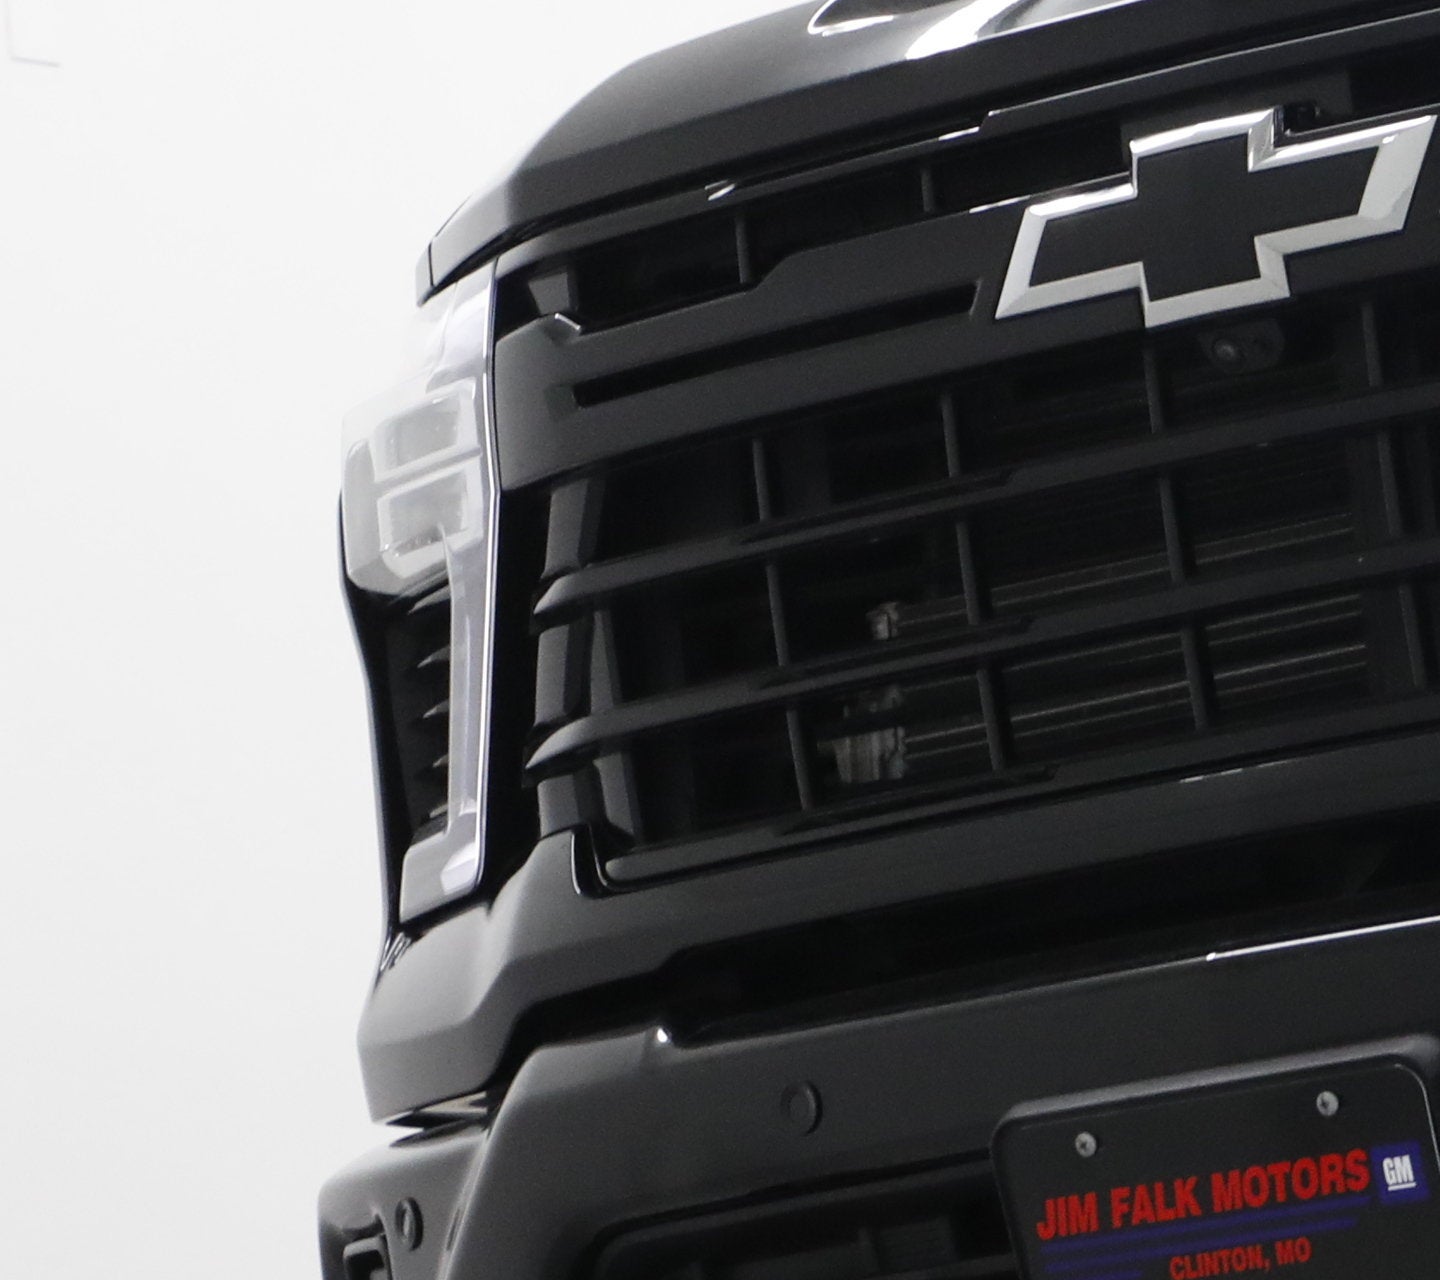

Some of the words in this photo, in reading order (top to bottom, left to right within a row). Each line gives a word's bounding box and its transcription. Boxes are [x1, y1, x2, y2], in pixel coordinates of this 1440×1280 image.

[1382, 1153, 1416, 1185] GM
[1035, 1192, 1100, 1241] JIM
[1109, 1175, 1203, 1229] FALK
[1210, 1147, 1372, 1214] MOTORS
[1274, 1236, 1313, 1266] MO
